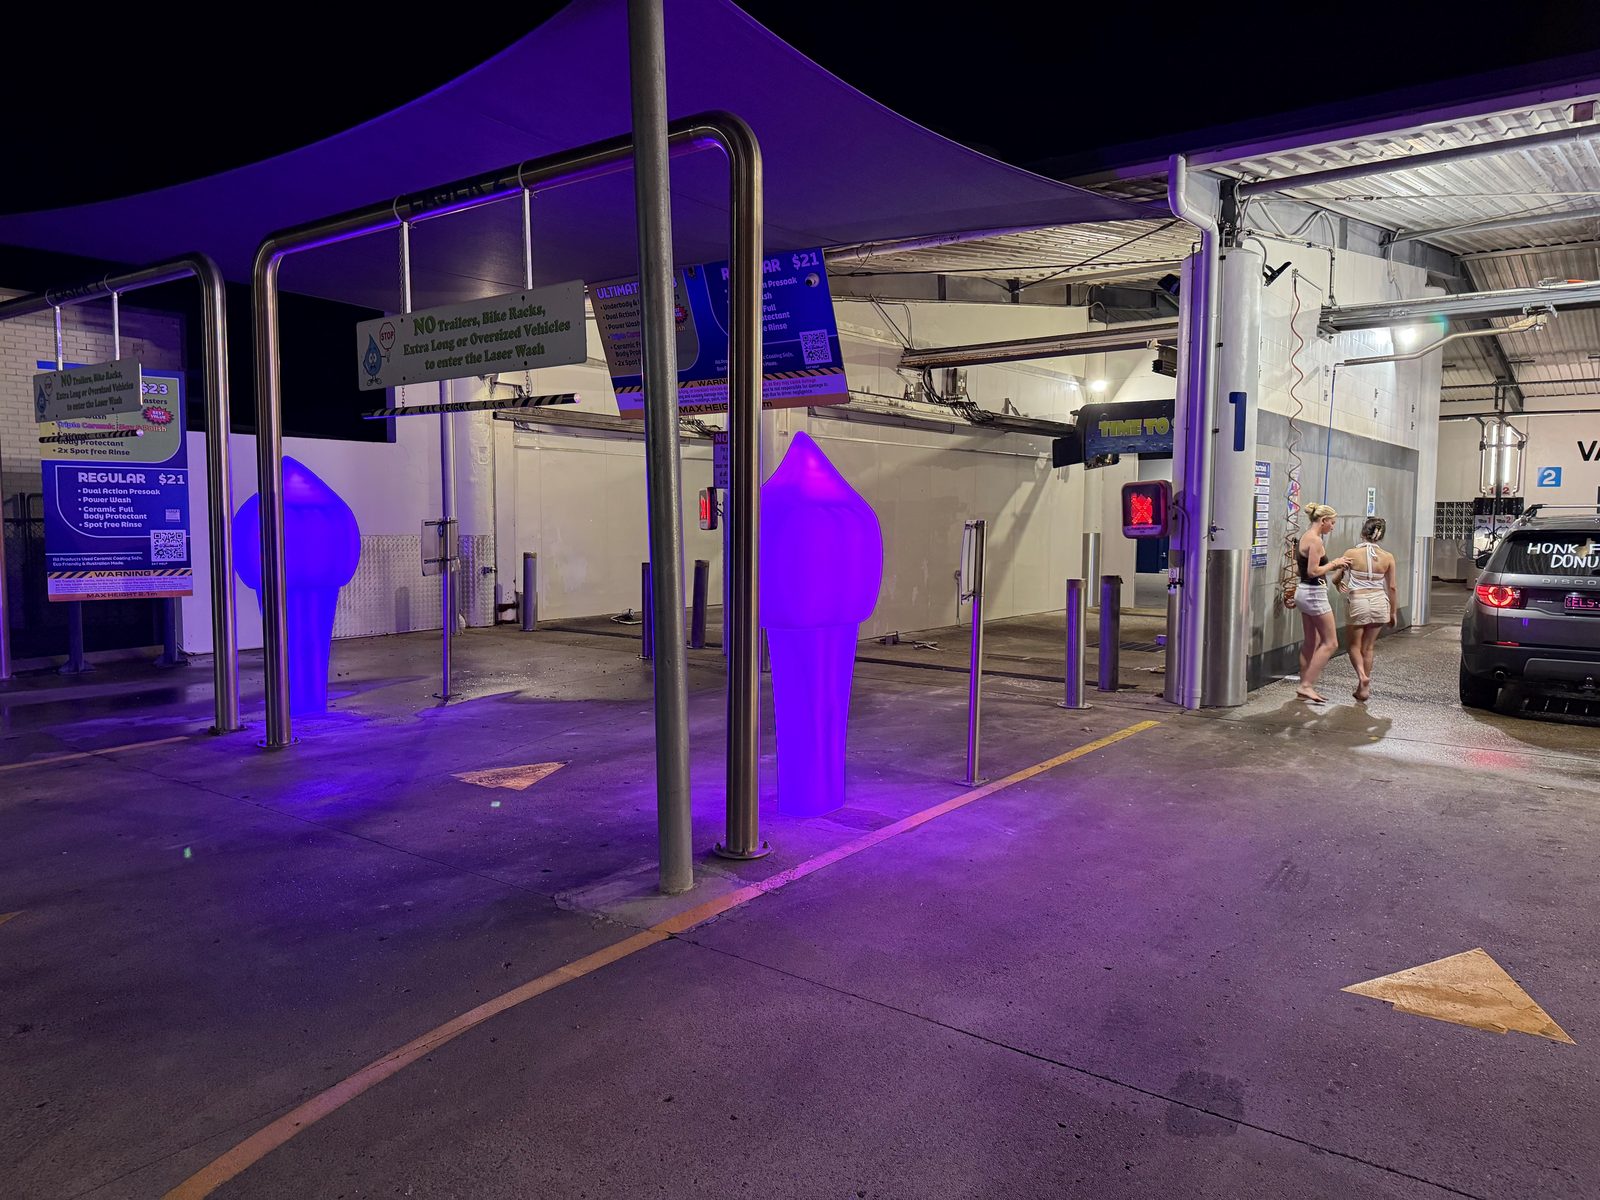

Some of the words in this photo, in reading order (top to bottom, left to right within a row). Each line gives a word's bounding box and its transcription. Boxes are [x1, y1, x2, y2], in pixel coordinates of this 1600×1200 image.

[792, 252, 820, 270] $21
[768, 277, 798, 287] Presoak
[596, 282, 639, 299] ULTIMAT
[603, 301, 632, 311] Underbody
[413, 315, 436, 337] NO
[437, 316, 481, 333] Trailers,
[482, 310, 507, 324] Bike
[508, 304, 546, 320] Racks,
[768, 323, 788, 331] Rinse
[380, 331, 394, 341] STOP
[403, 343, 430, 356] Extra
[431, 339, 455, 351] Long
[456, 336, 468, 347] or
[469, 325, 522, 346] Oversized
[523, 320, 571, 337] Vehicles
[425, 359, 435, 370] to
[437, 355, 463, 368] enter
[465, 351, 482, 365] the
[484, 348, 513, 362] Laser
[515, 342, 545, 358] Wash
[60, 373, 72, 388] NO
[697, 378, 728, 387] WARN
[141, 382, 168, 395] $23
[439, 402, 470, 412] HEIGHT
[679, 404, 704, 413] MAX
[704, 402, 728, 411] HEIG
[1229, 392, 1247, 451] 1
[1099, 418, 1143, 437] TIME
[1143, 417, 1170, 435] TO
[80, 438, 124, 447] Protectant
[70, 447, 89, 455] Spot
[90, 447, 107, 456] free
[77, 472, 146, 484] REGULAR
[158, 472, 185, 486] $21
[1542, 469, 1557, 485] 2
[82, 487, 101, 495] Dual
[102, 487, 128, 495] Action
[1489, 486, 1494, 495] 1
[1502, 486, 1510, 495] 2
[83, 513, 104, 521] Body
[83, 521, 103, 529] Spot
[104, 521, 120, 529] free
[1527, 542, 1579, 555] HONK
[94, 570, 152, 578] WARNING
